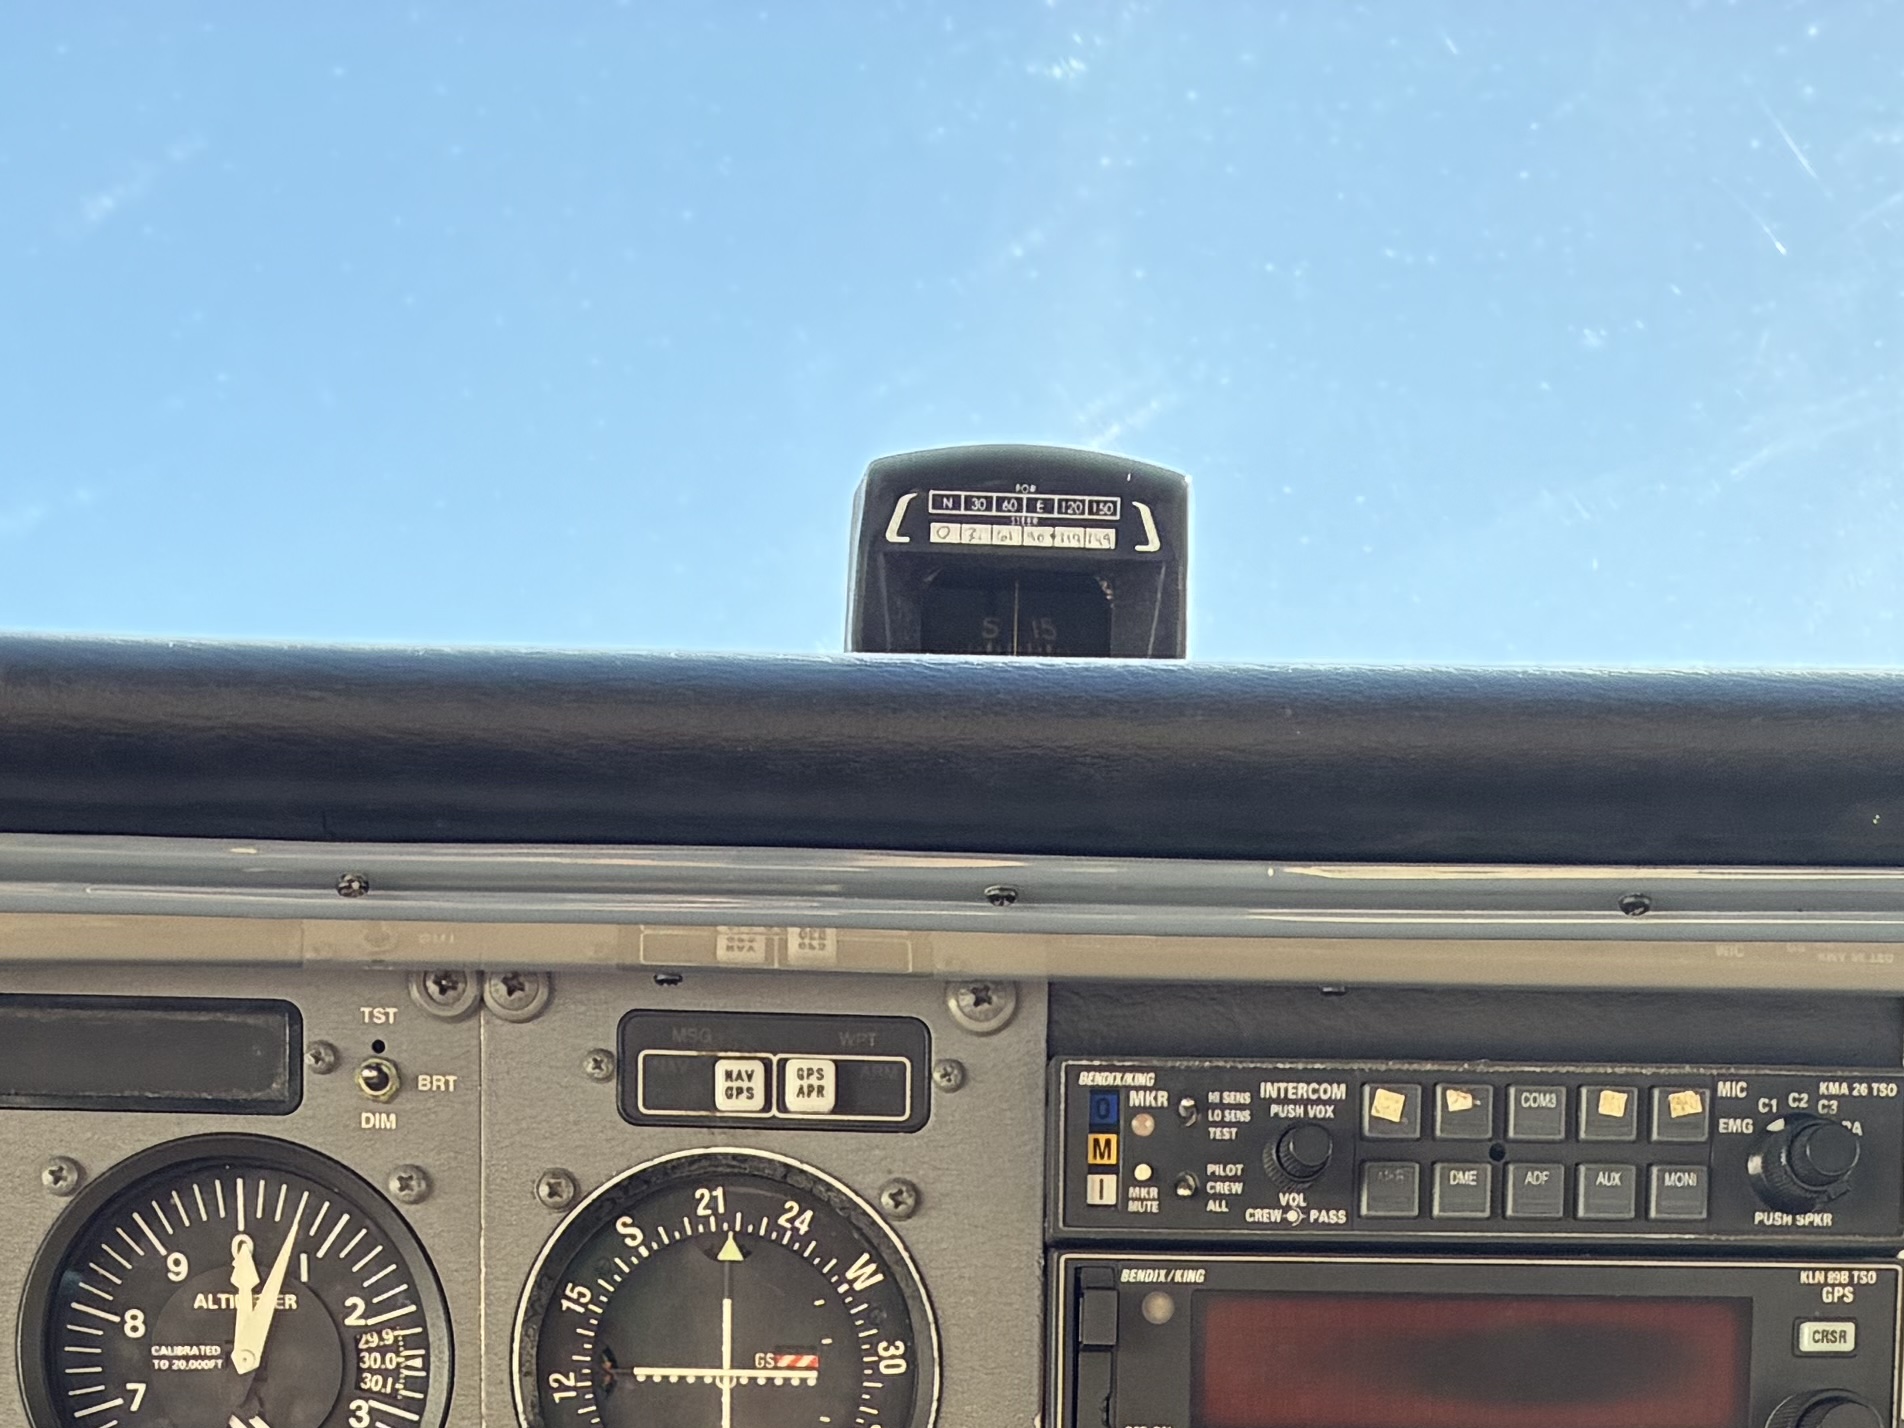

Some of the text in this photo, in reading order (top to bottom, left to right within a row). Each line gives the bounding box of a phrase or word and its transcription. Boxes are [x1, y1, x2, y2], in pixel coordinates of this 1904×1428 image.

[942, 496, 1115, 516] N 30 60 E 120 150
[359, 1006, 399, 1025] TST
[417, 1074, 458, 1093] BRT
[1259, 1081, 1347, 1101] INTERCOM
[1128, 1089, 1169, 1108] MKR
[360, 1111, 397, 1130] DIM
[1269, 1103, 1335, 1119] PUSH VOX
[1821, 1285, 1854, 1304] GPS
[1811, 1328, 1848, 1345] CRSR
